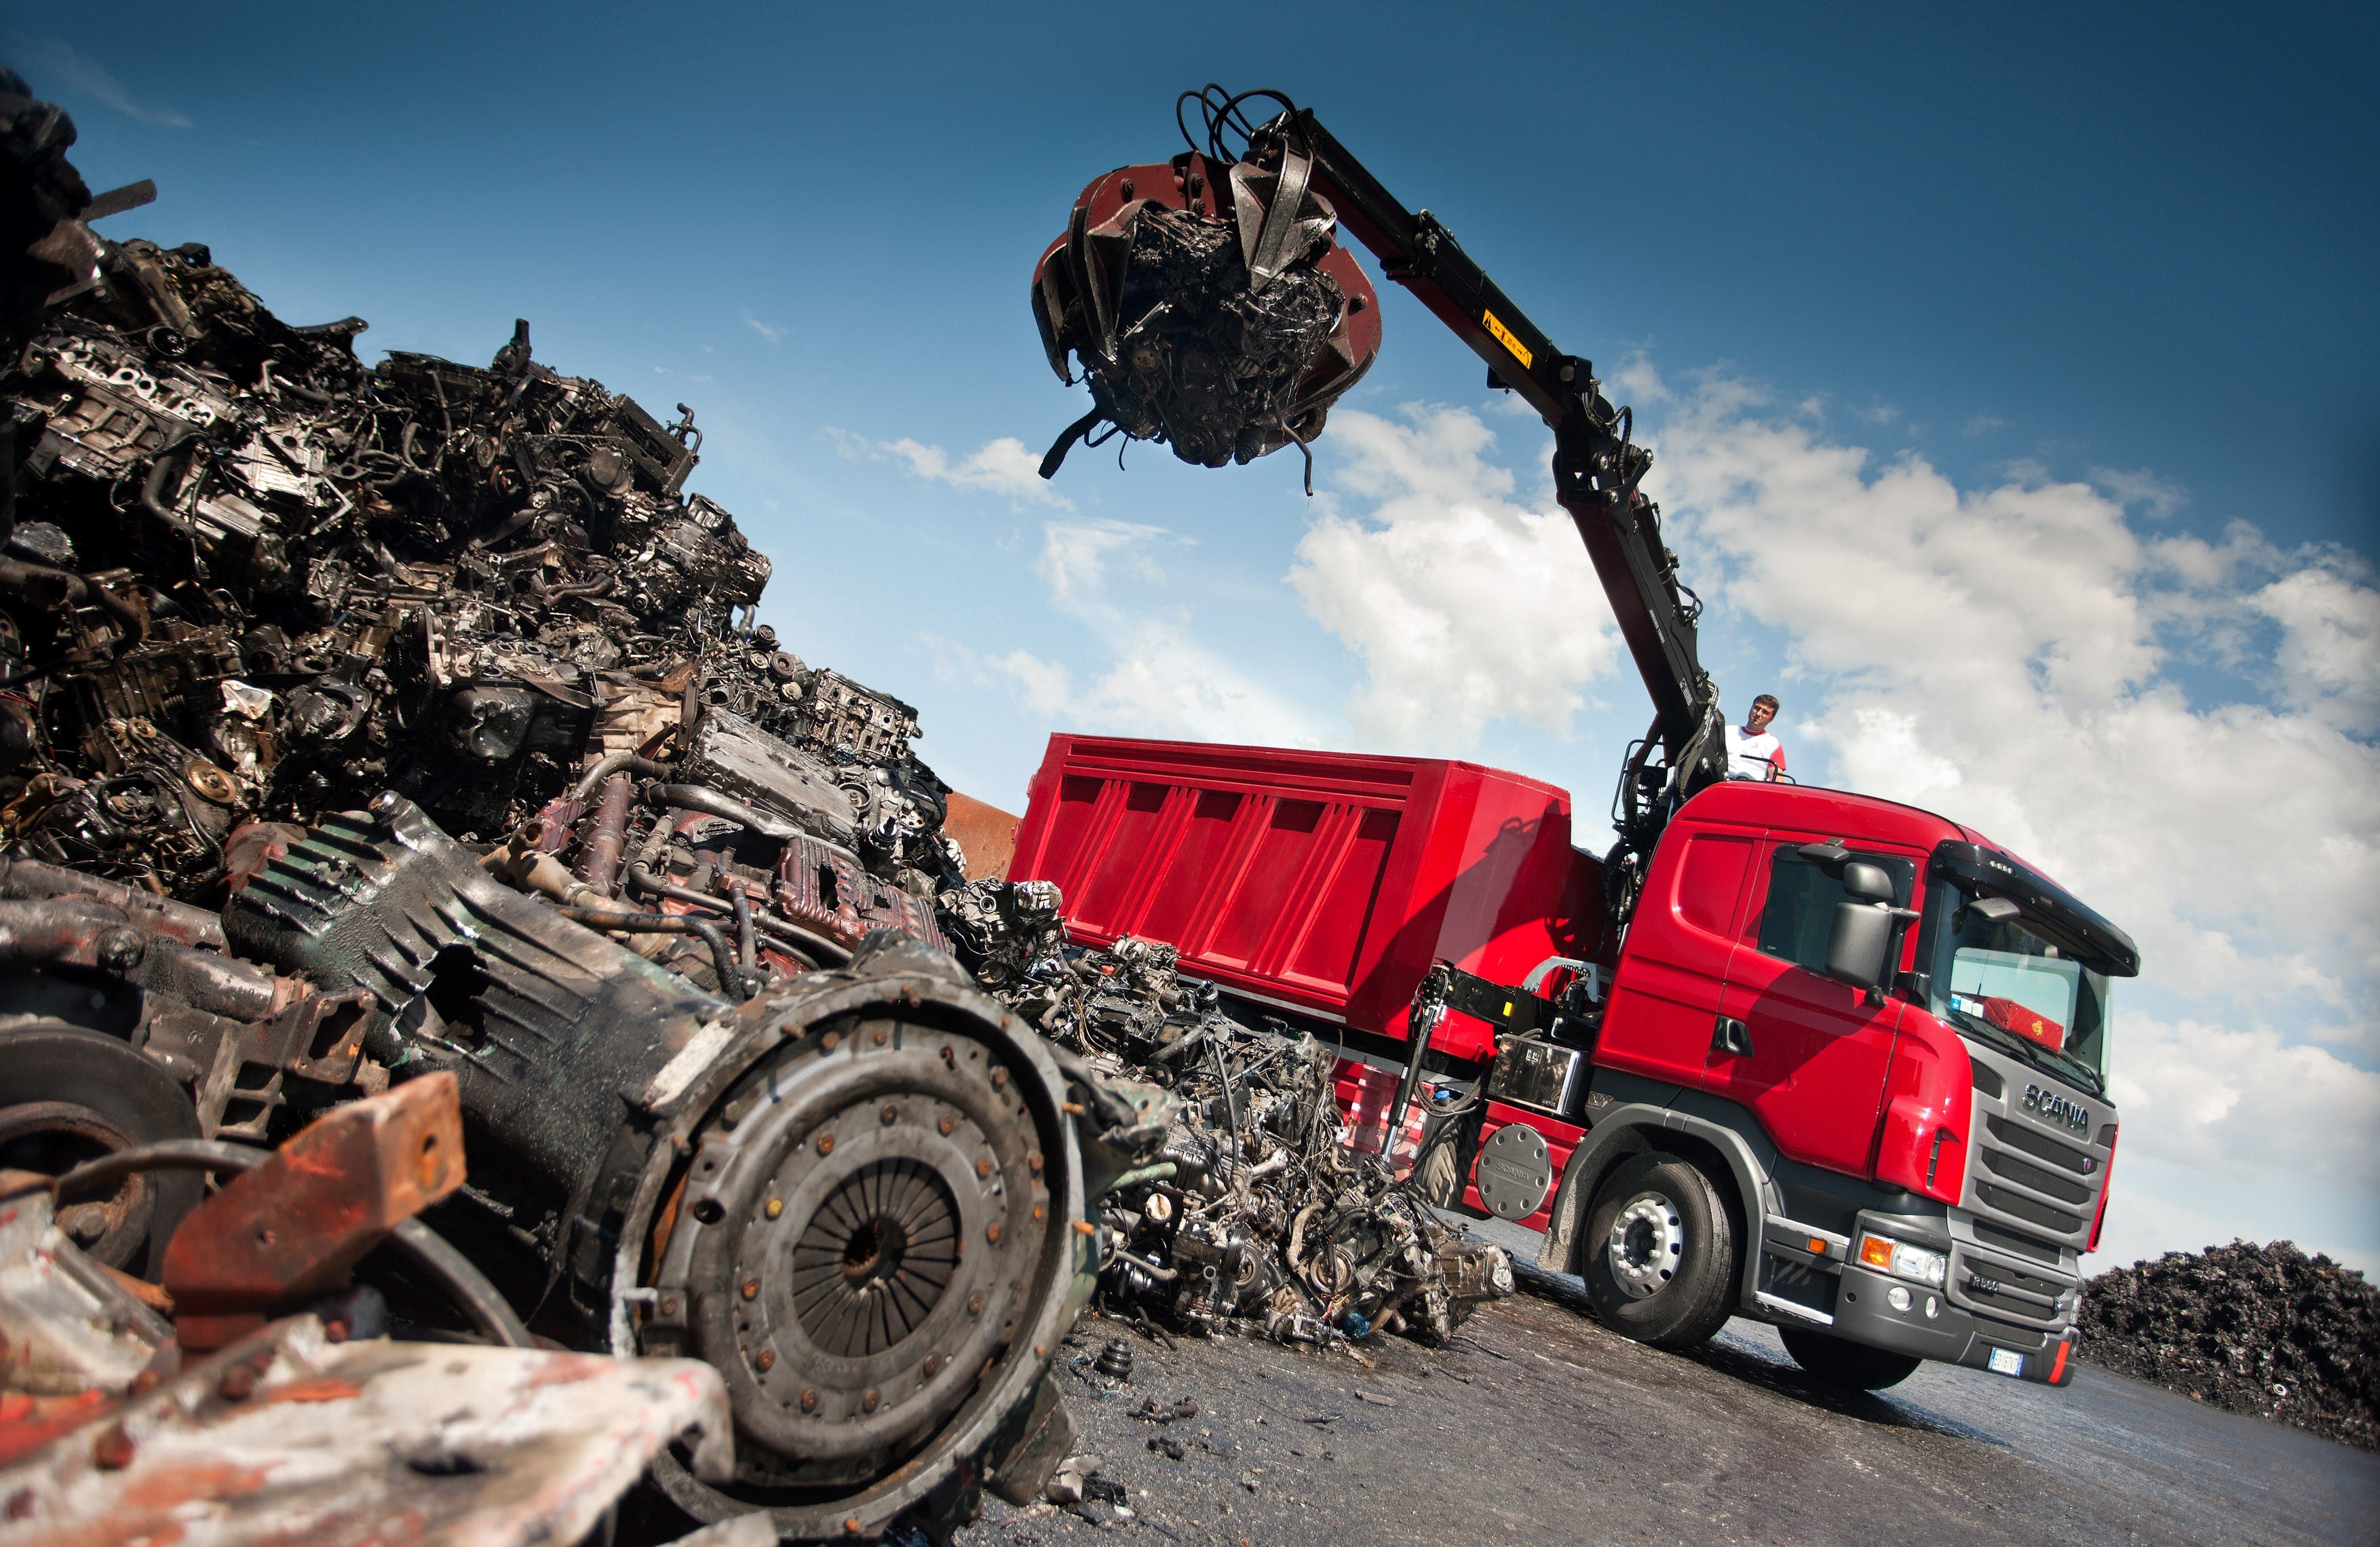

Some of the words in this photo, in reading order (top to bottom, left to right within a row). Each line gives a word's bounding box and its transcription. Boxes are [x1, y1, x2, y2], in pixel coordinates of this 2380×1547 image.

[1507, 337, 1512, 345] 20
[1683, 687, 1693, 706] HIAB
[2022, 1084, 2088, 1135] SCANIA
[1496, 1162, 1529, 1181] SCANIA
